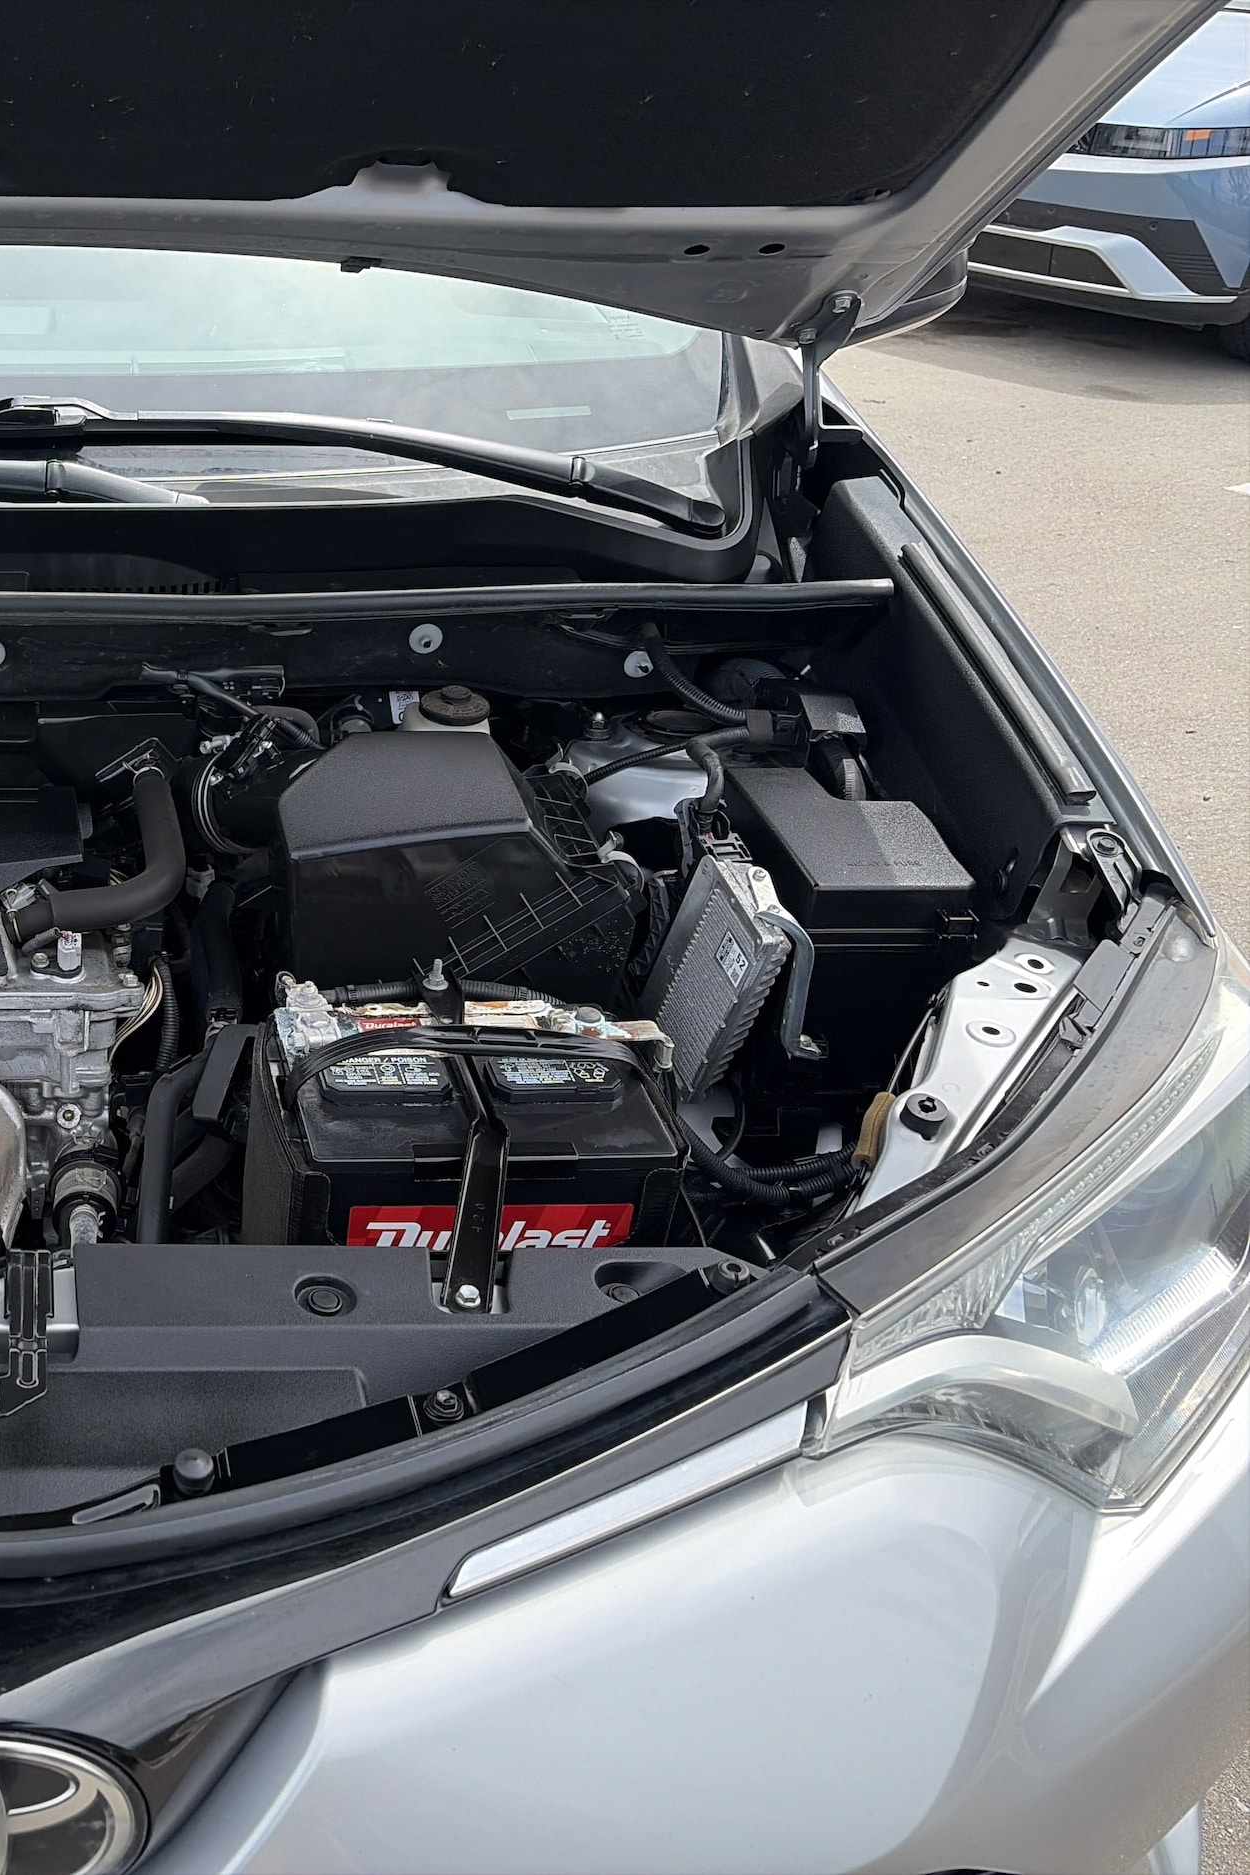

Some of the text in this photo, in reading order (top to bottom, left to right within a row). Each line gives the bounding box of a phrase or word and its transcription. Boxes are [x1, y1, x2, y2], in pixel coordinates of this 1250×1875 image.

[735, 953, 746, 971] 52
[362, 1021, 417, 1030] Duralast
[366, 1219, 612, 1251] Dulast
